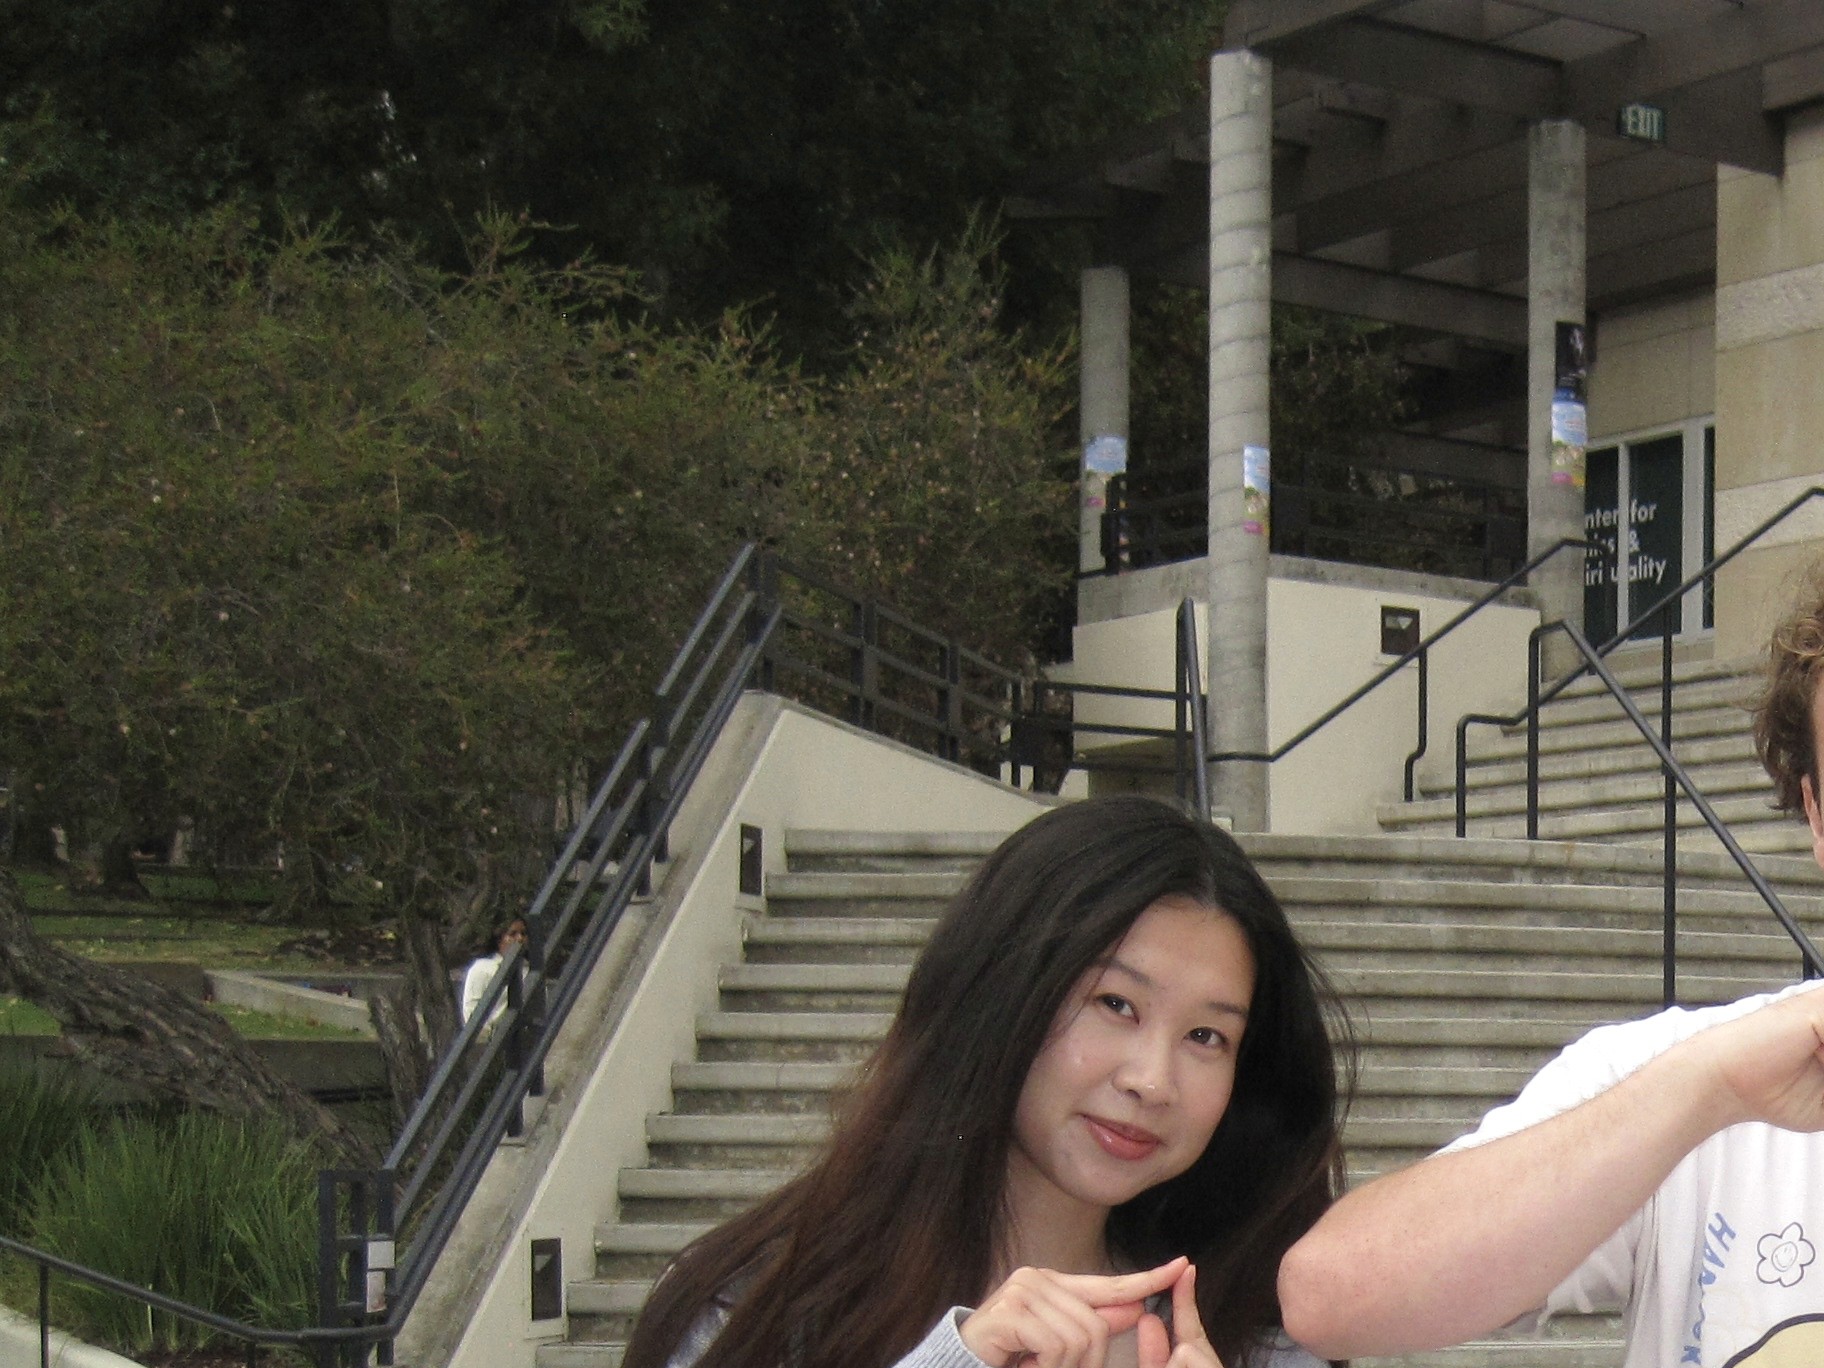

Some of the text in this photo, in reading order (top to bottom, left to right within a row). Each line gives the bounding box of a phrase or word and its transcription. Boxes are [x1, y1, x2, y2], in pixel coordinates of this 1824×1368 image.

[1627, 105, 1660, 139] EXIT
[1585, 499, 1657, 529] nter for
[1629, 529, 1641, 553] &
